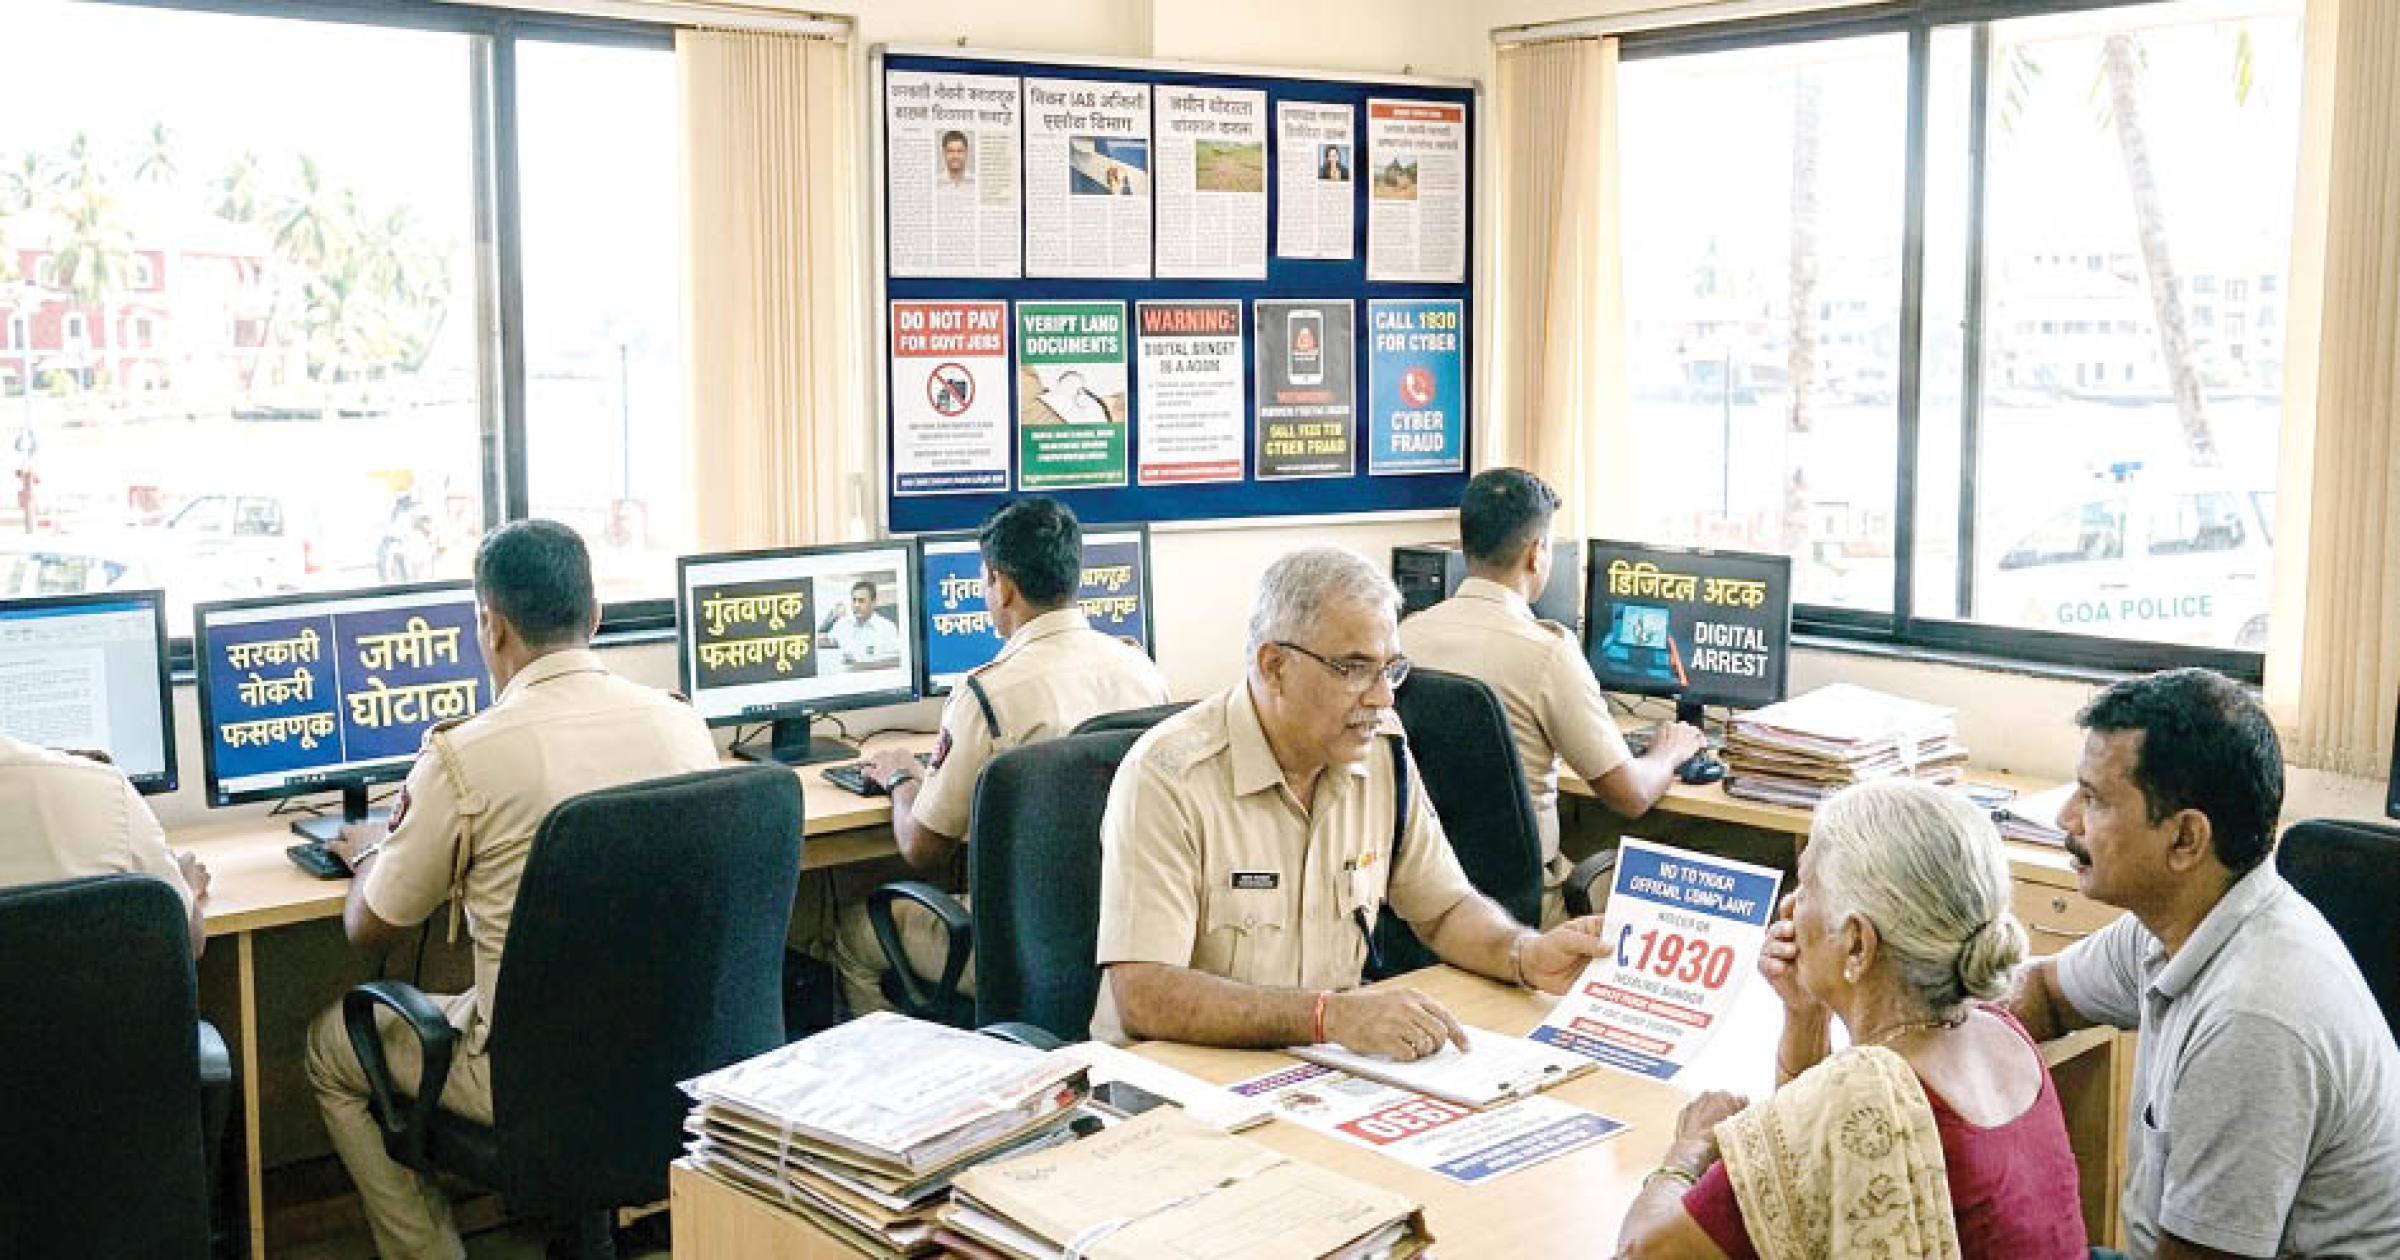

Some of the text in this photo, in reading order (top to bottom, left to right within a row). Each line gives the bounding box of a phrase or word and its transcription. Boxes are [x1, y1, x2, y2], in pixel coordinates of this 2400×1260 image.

[901, 310, 998, 329] DO NOT PAY
[1081, 314, 1118, 332] LAND
[1144, 309, 1235, 332] WARNING:
[1377, 311, 1414, 329] CALL
[1026, 336, 1118, 354] DOCUMENTS
[1377, 333, 1405, 351] FOR
[1391, 433, 1443, 453] FRAUD
[939, 573, 984, 610] गुंतव
[1607, 559, 1767, 609] डिजिटल अटक
[702, 591, 804, 636] गुंतवणूक
[2057, 595, 2214, 624] GOA POLICE
[226, 627, 321, 671] सरकारी
[356, 616, 461, 671] जमीन
[1695, 621, 1768, 652] DIGITAL
[698, 634, 811, 674] फसवणूक
[1691, 649, 1768, 678] ARREST
[238, 666, 314, 707] नोकरी
[347, 677, 478, 729] घोटाळा
[220, 711, 336, 751] फसवणूक
[1636, 928, 1736, 991] 1930
